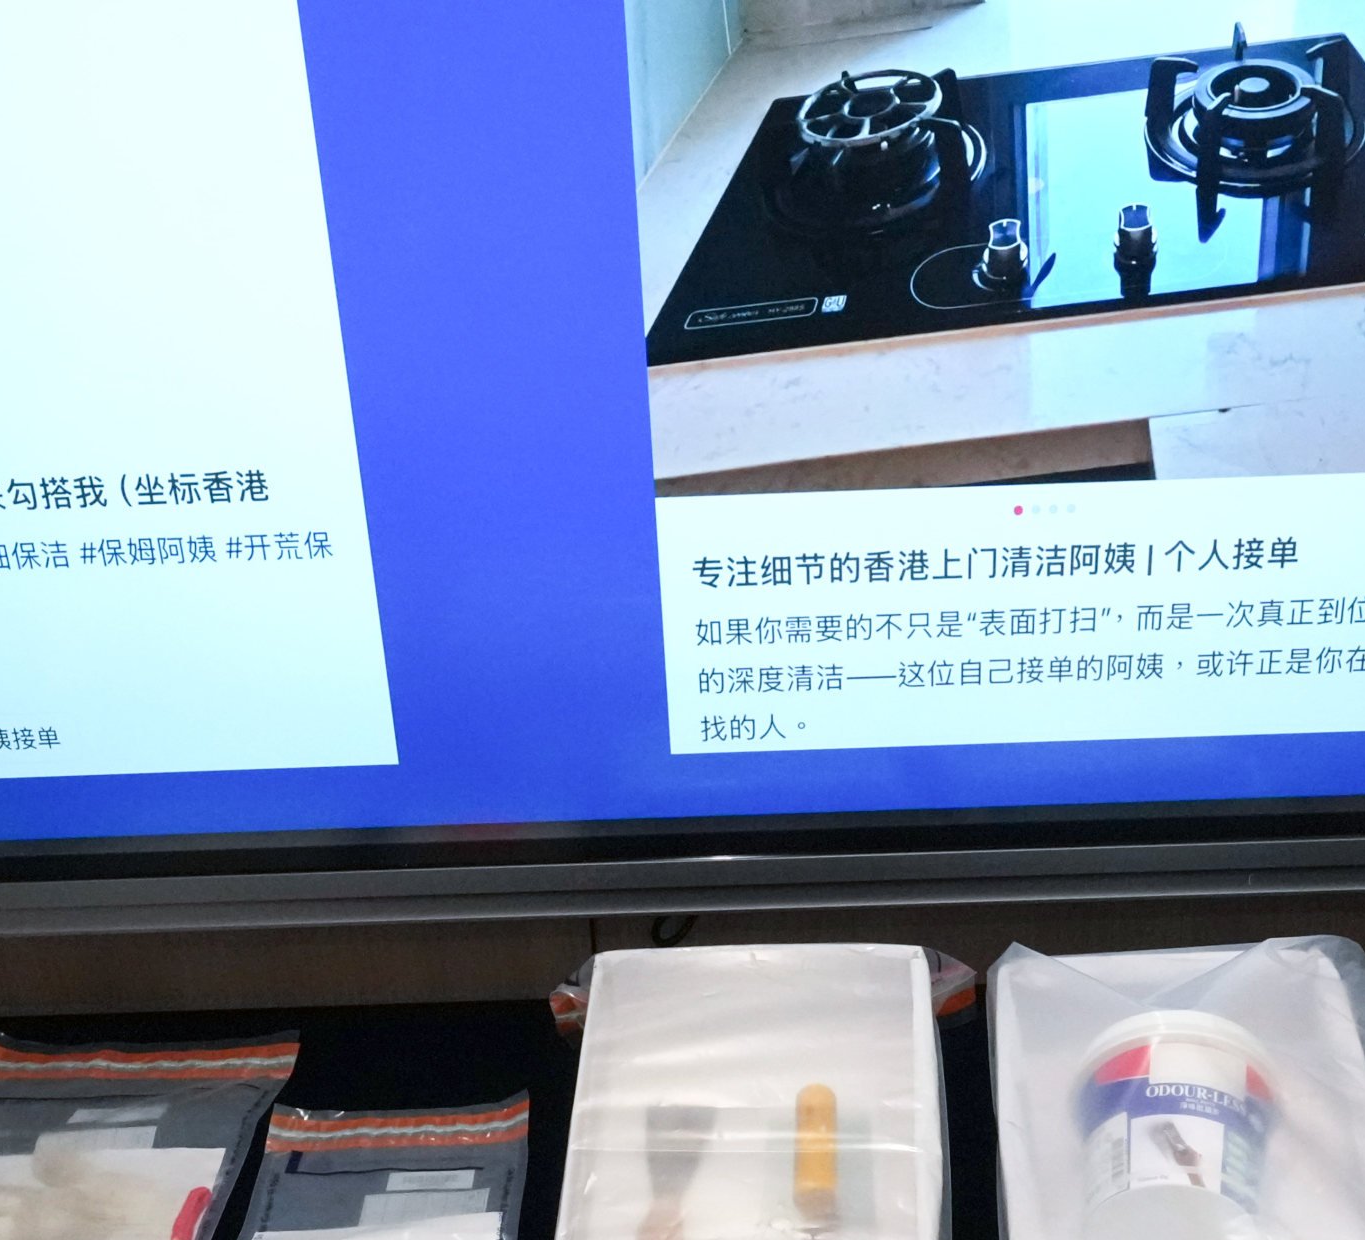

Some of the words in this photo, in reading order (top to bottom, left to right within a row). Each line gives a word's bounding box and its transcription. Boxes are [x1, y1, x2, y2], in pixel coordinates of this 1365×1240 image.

[80, 535, 217, 567] #保姆阿姨
[226, 531, 333, 561] #开荒保
[692, 542, 1136, 588] 专注细节的香港上门清洁阿姨
[1165, 536, 1298, 572] 个人接单
